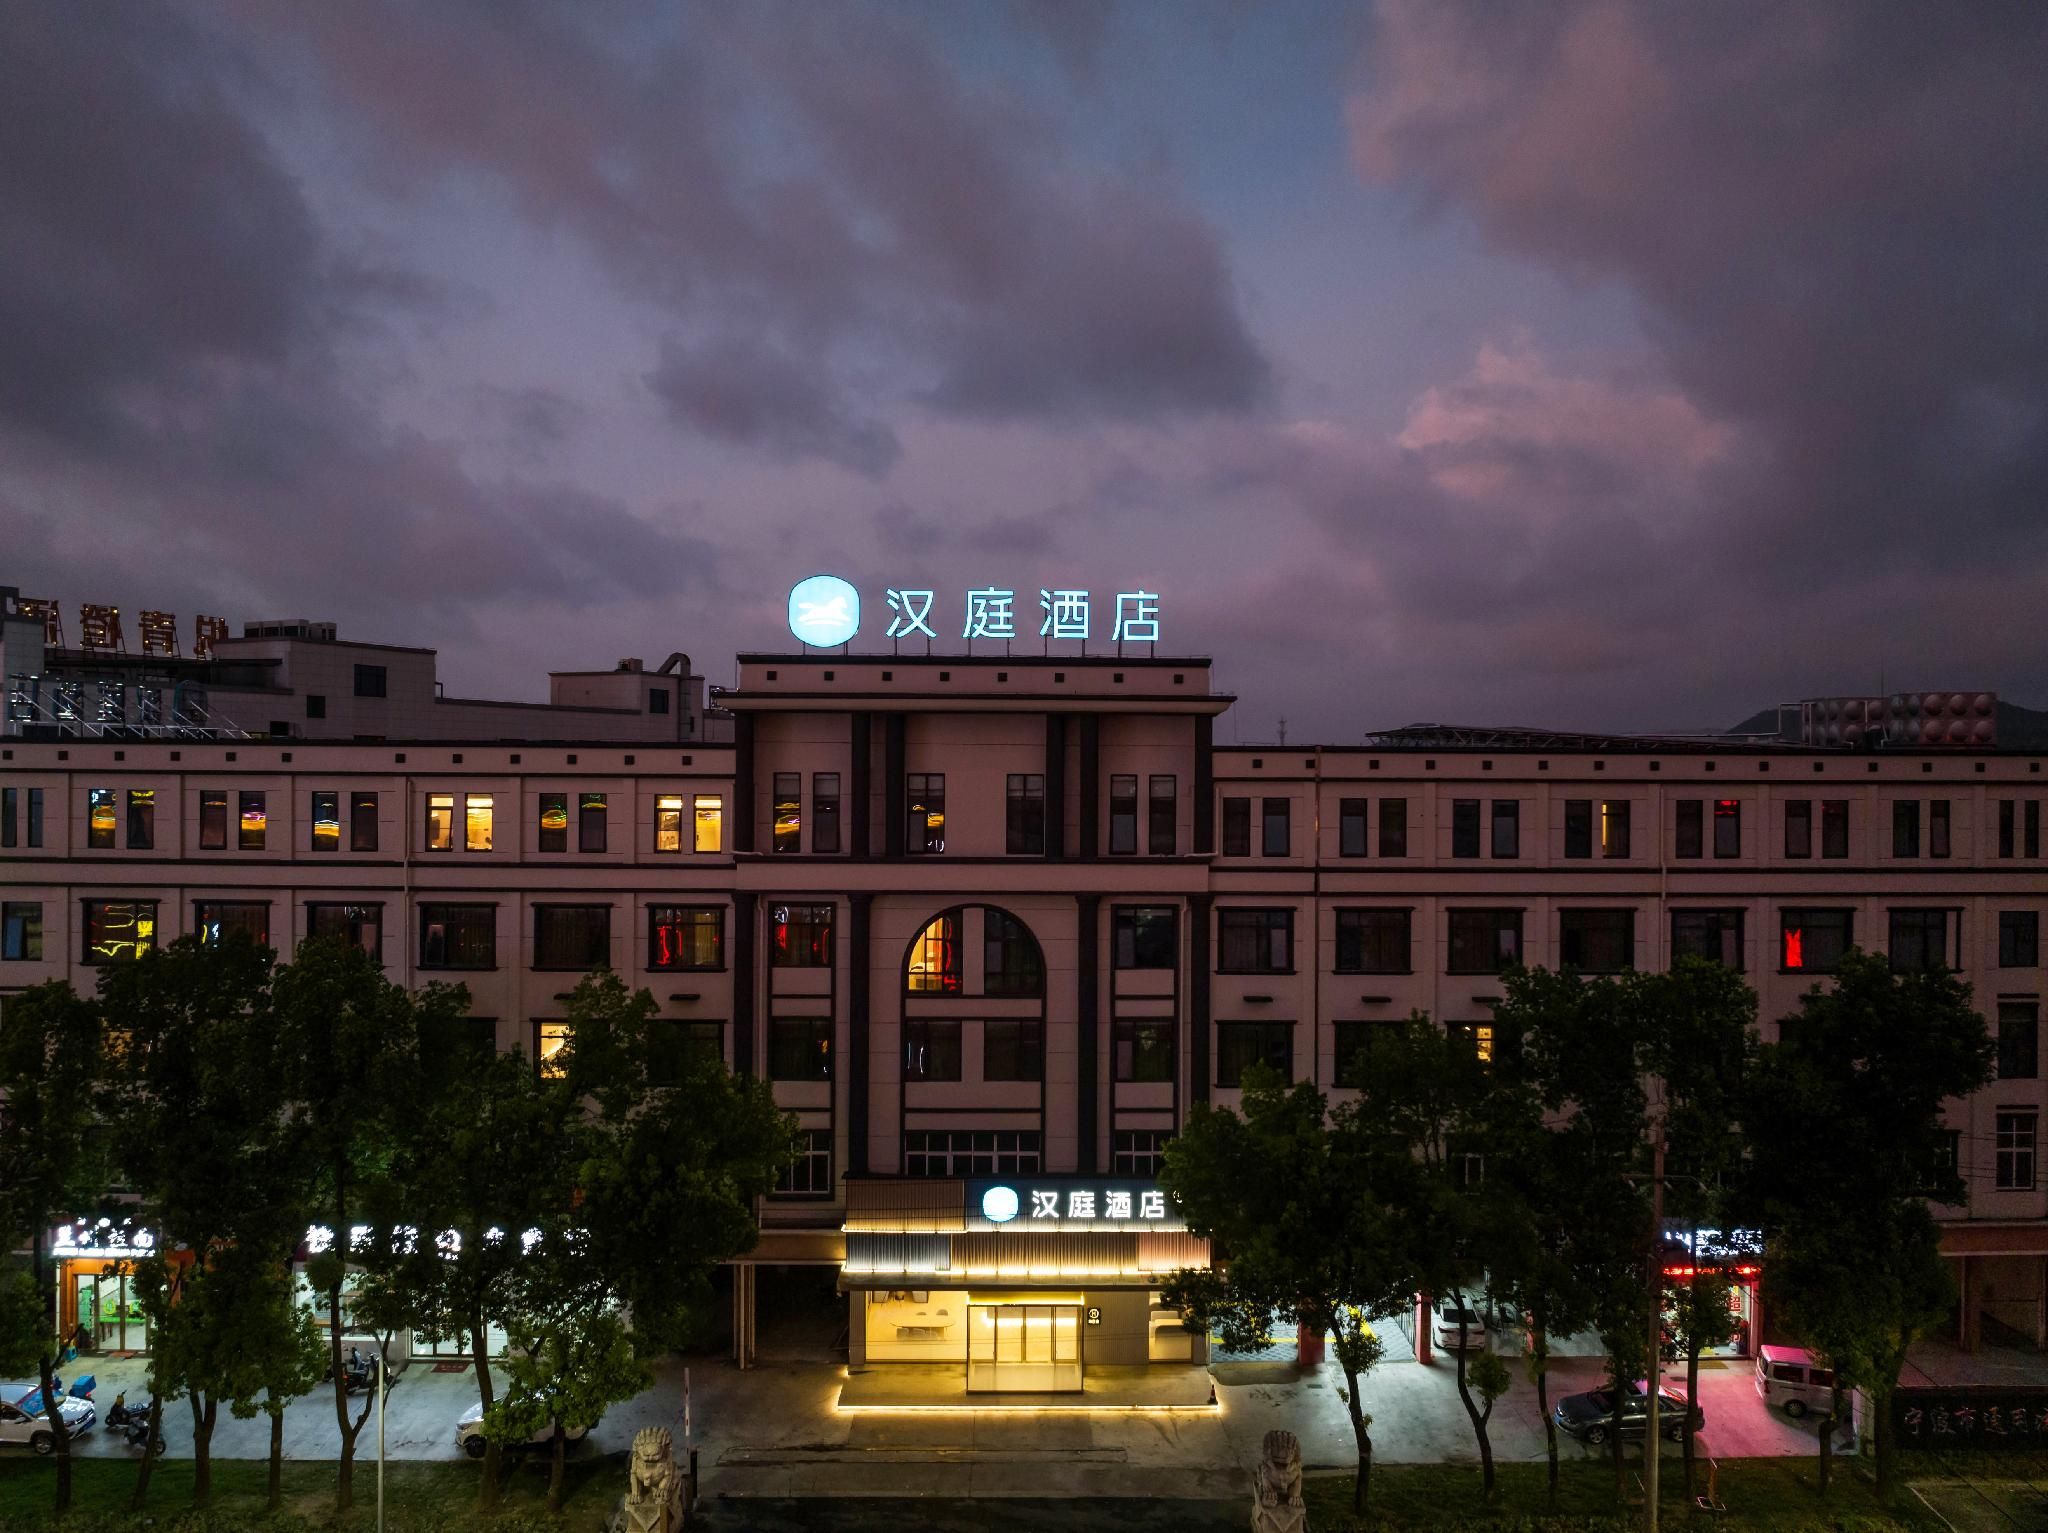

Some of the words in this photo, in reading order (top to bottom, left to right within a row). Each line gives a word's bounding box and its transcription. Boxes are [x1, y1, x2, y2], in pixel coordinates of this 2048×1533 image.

[884, 586, 1161, 641] 汉庭酒店
[1031, 1190, 1165, 1219] 汉庭酒店
